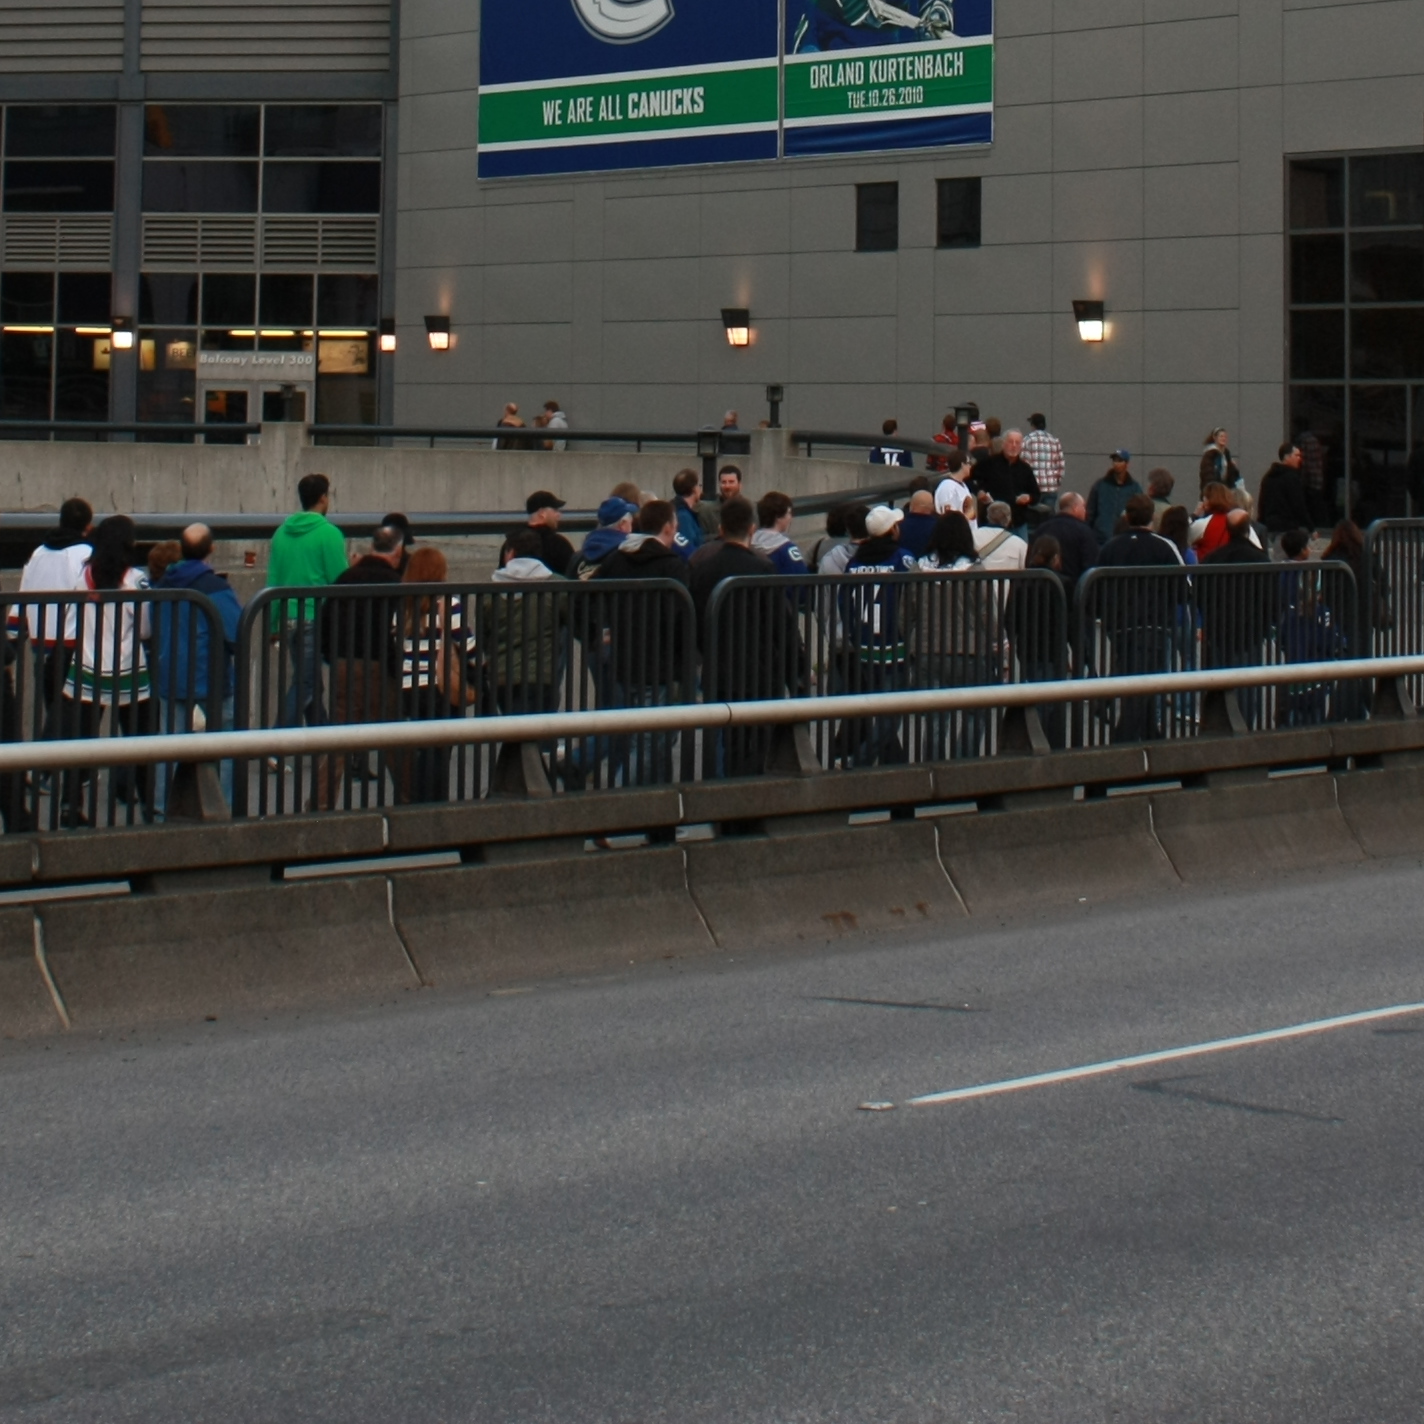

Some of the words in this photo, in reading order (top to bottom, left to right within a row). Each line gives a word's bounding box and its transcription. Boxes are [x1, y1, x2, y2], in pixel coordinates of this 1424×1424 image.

[810, 61, 865, 89] ORLAND
[869, 51, 964, 84] KURTENBACH
[542, 99, 563, 126] WE
[567, 96, 594, 124] ARE
[598, 94, 623, 121] ALL
[627, 86, 705, 119] CANUCKS
[172, 347, 196, 358] BEE
[199, 354, 248, 366] Balcony
[252, 355, 285, 364] Level
[289, 355, 313, 364] 300
